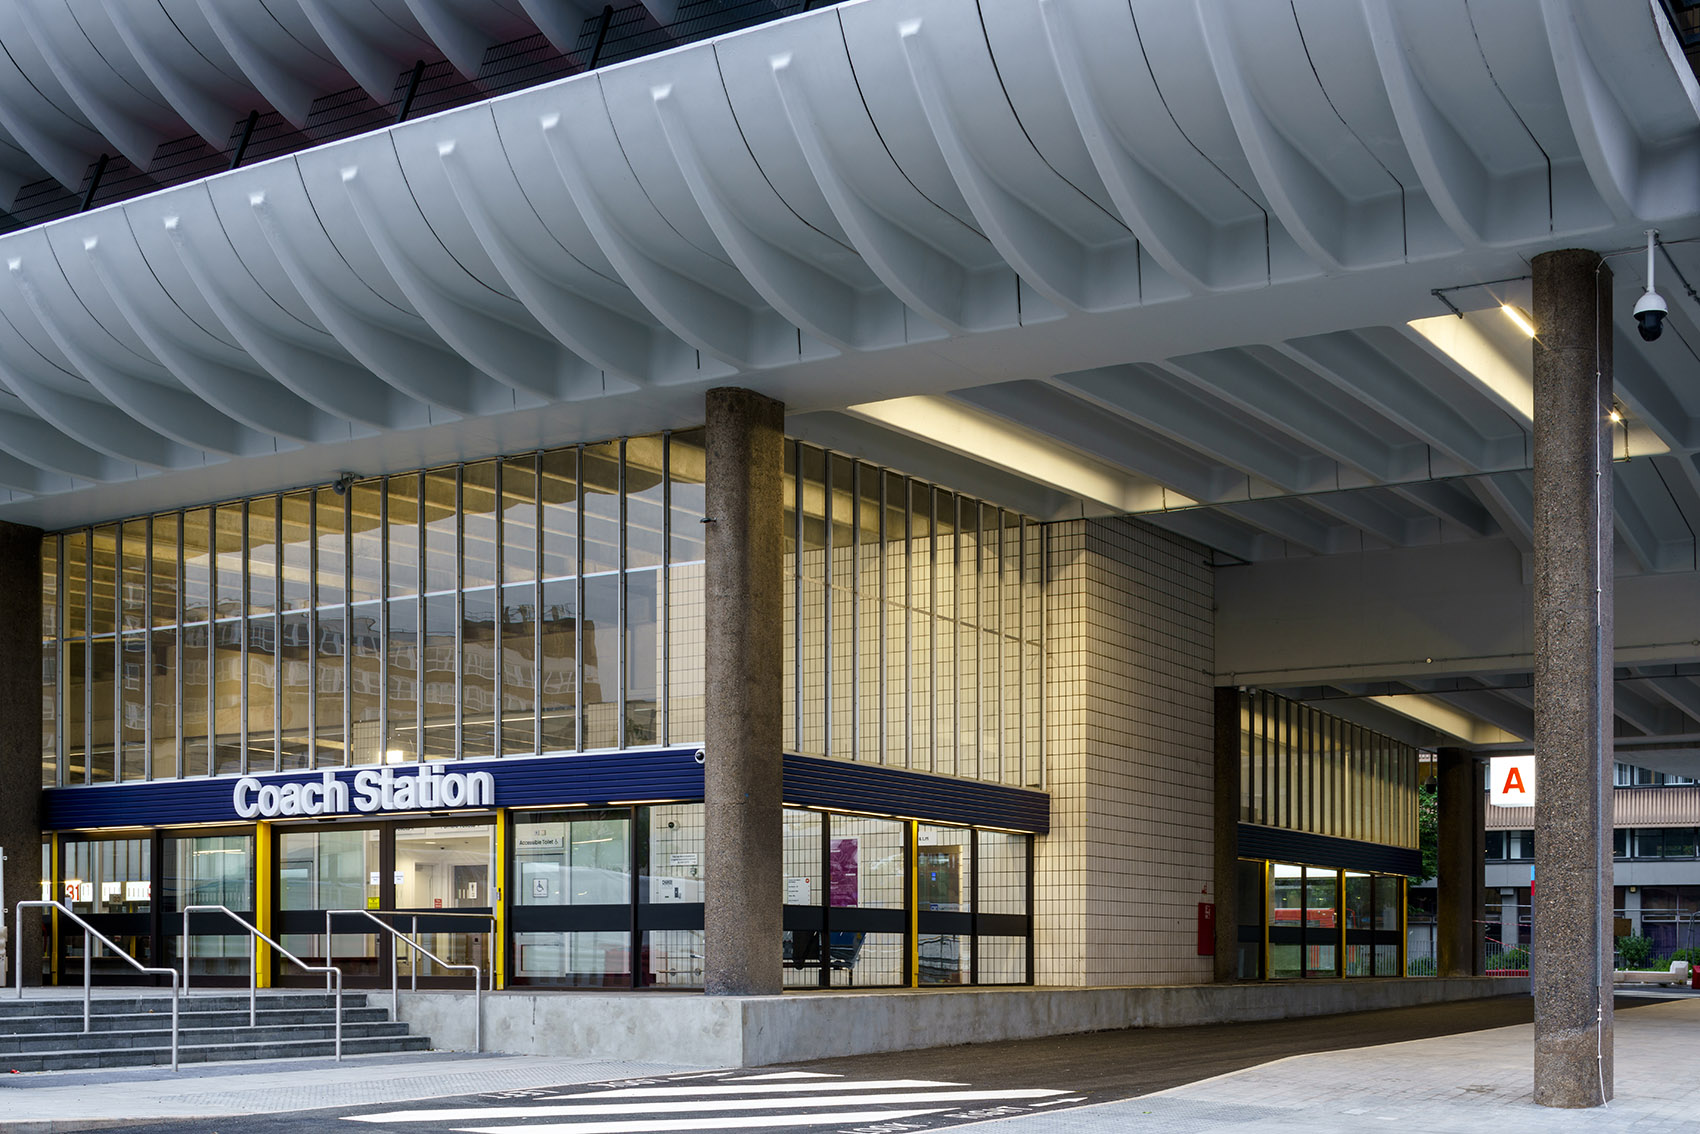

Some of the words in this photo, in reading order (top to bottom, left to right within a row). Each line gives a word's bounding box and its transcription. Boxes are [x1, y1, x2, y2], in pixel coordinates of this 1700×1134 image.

[233, 772, 349, 818] Coach
[353, 765, 495, 812] Station
[1502, 767, 1526, 794] A
[66, 884, 80, 901] 31
